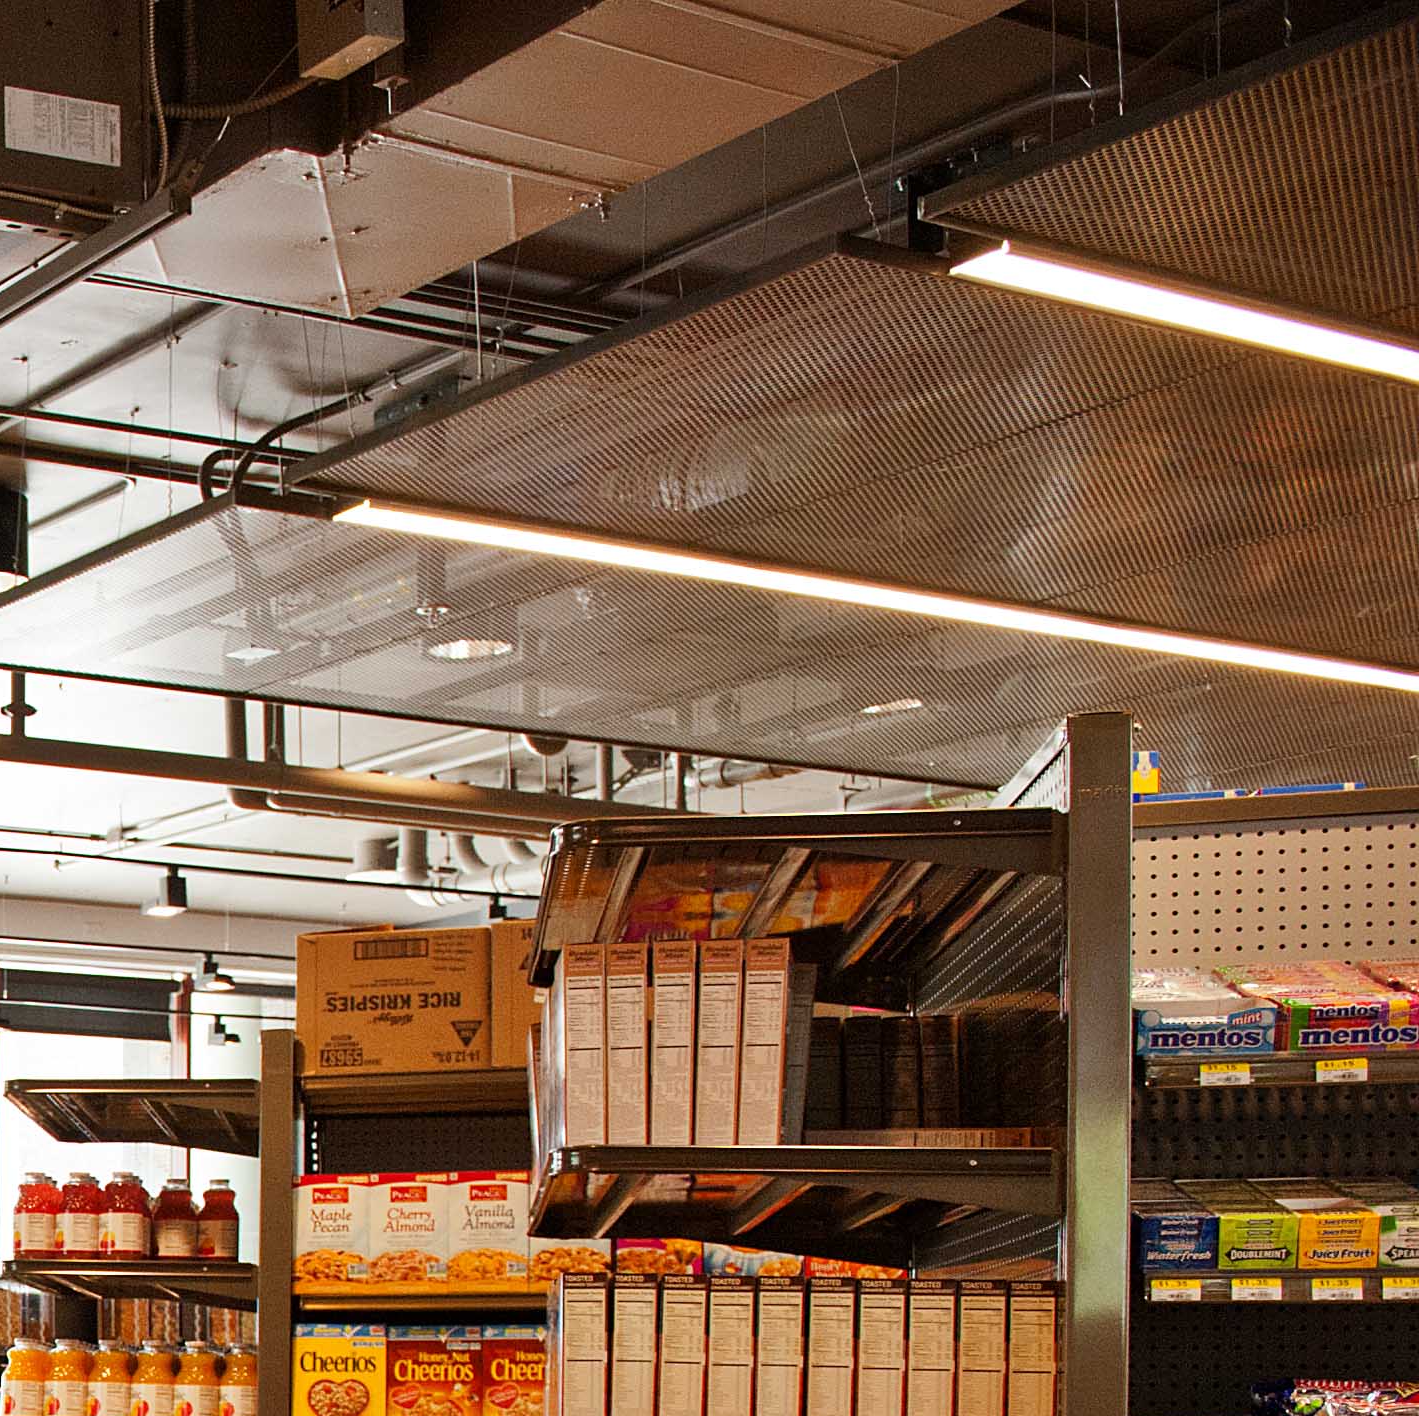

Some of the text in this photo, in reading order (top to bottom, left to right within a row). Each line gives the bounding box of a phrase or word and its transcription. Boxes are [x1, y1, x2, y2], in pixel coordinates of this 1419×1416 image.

[325, 991, 461, 1012] RICE KRISPIES
[1232, 1010, 1263, 1026] mint
[1149, 1028, 1263, 1048] mentos
[1301, 1024, 1418, 1046] mentos
[320, 1048, 363, 1067] 59687
[310, 1207, 353, 1224] Maple
[386, 1207, 432, 1223] Cherry
[463, 1204, 514, 1218] Vanilla
[312, 1222, 350, 1233] Pecan
[383, 1220, 436, 1233] Almond
[463, 1217, 515, 1230] Almond
[1146, 1250, 1213, 1262] Winterfresh
[1229, 1249, 1288, 1261] DOUBLEMINT
[1309, 1249, 1372, 1259] Juicy Fruit
[299, 1352, 377, 1373] Cheerios
[418, 1352, 470, 1363] Honey Nut
[394, 1359, 474, 1382] Cheerios
